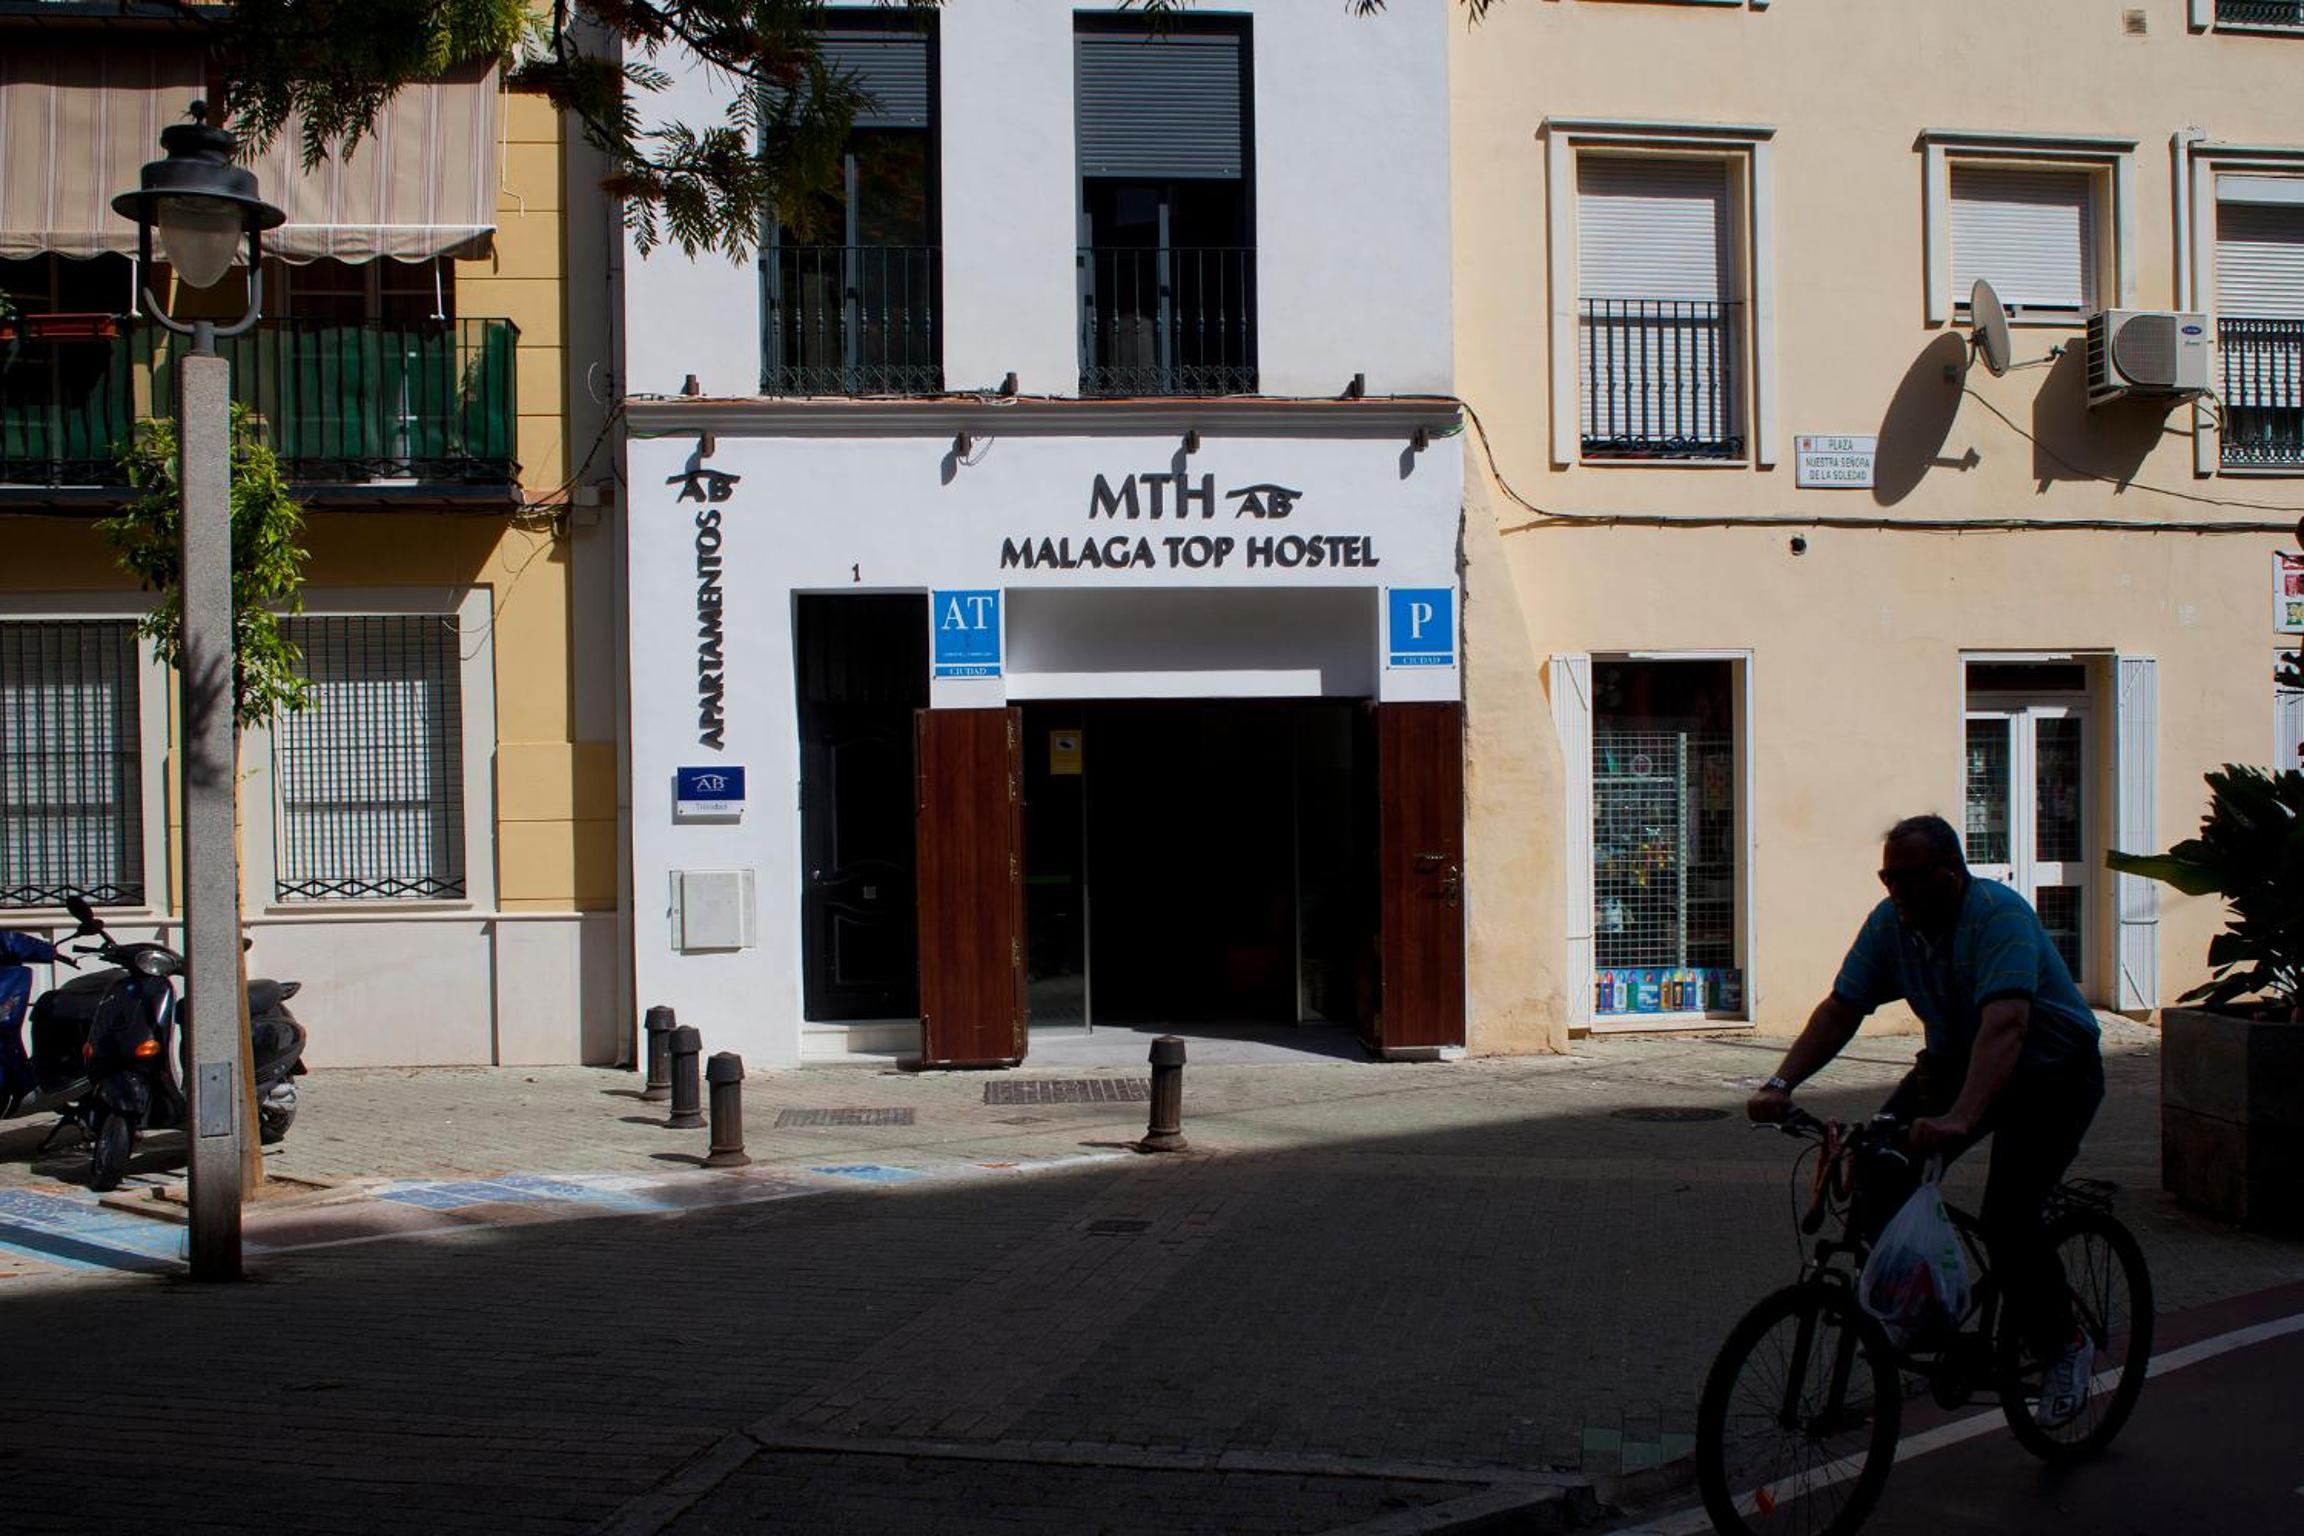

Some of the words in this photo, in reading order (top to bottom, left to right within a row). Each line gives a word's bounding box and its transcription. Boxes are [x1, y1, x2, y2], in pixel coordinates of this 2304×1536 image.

[1828, 438, 1853, 451] PLAZA
[1806, 456, 1838, 468] NUESTRA
[1809, 469, 1820, 480] DE
[1821, 469, 1831, 480] LA
[1833, 469, 1867, 480] SOLEDAD
[674, 471, 734, 503] AB
[1089, 473, 1215, 520] MTH
[1234, 486, 1296, 519] AB
[1000, 536, 1156, 569] MALAGA
[1162, 536, 1235, 569] TOP
[1246, 535, 1380, 568] HOSTEL
[852, 563, 861, 582] 1
[941, 596, 993, 630] AT
[1408, 602, 1433, 640] P
[695, 509, 724, 752] APARTAMENTOS
[1403, 656, 1441, 665] CIUDAD
[950, 667, 987, 676] CIUDAD
[695, 776, 727, 790] AB
